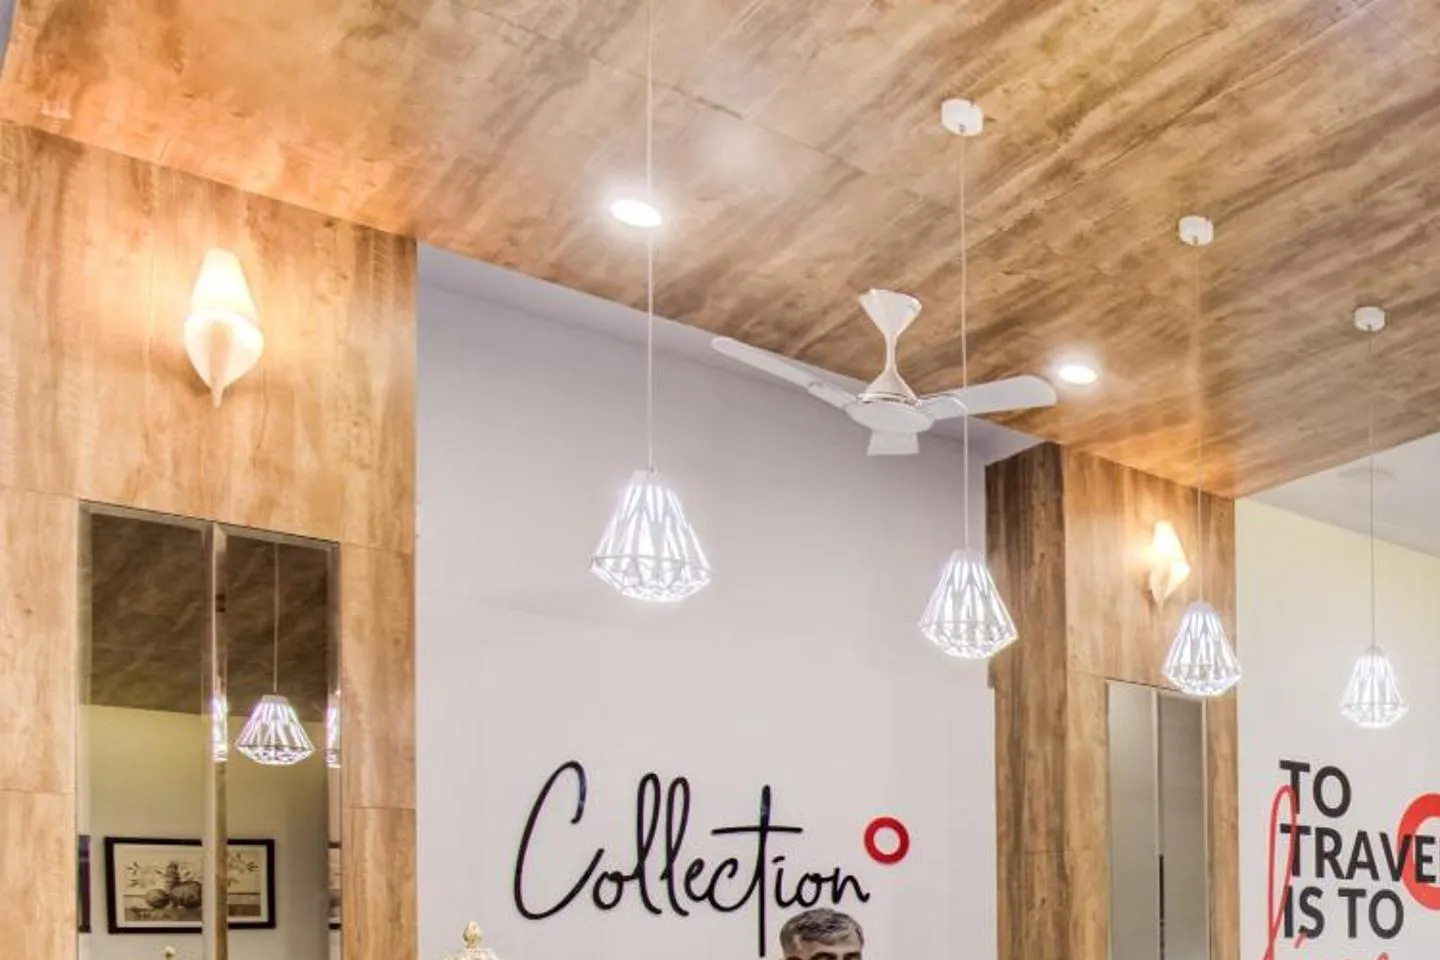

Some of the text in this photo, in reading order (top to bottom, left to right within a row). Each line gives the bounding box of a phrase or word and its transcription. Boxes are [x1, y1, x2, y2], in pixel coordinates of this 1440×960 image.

[1279, 759, 1352, 819] TO
[514, 760, 871, 957] Collection
[1283, 885, 1405, 939] IS TO
